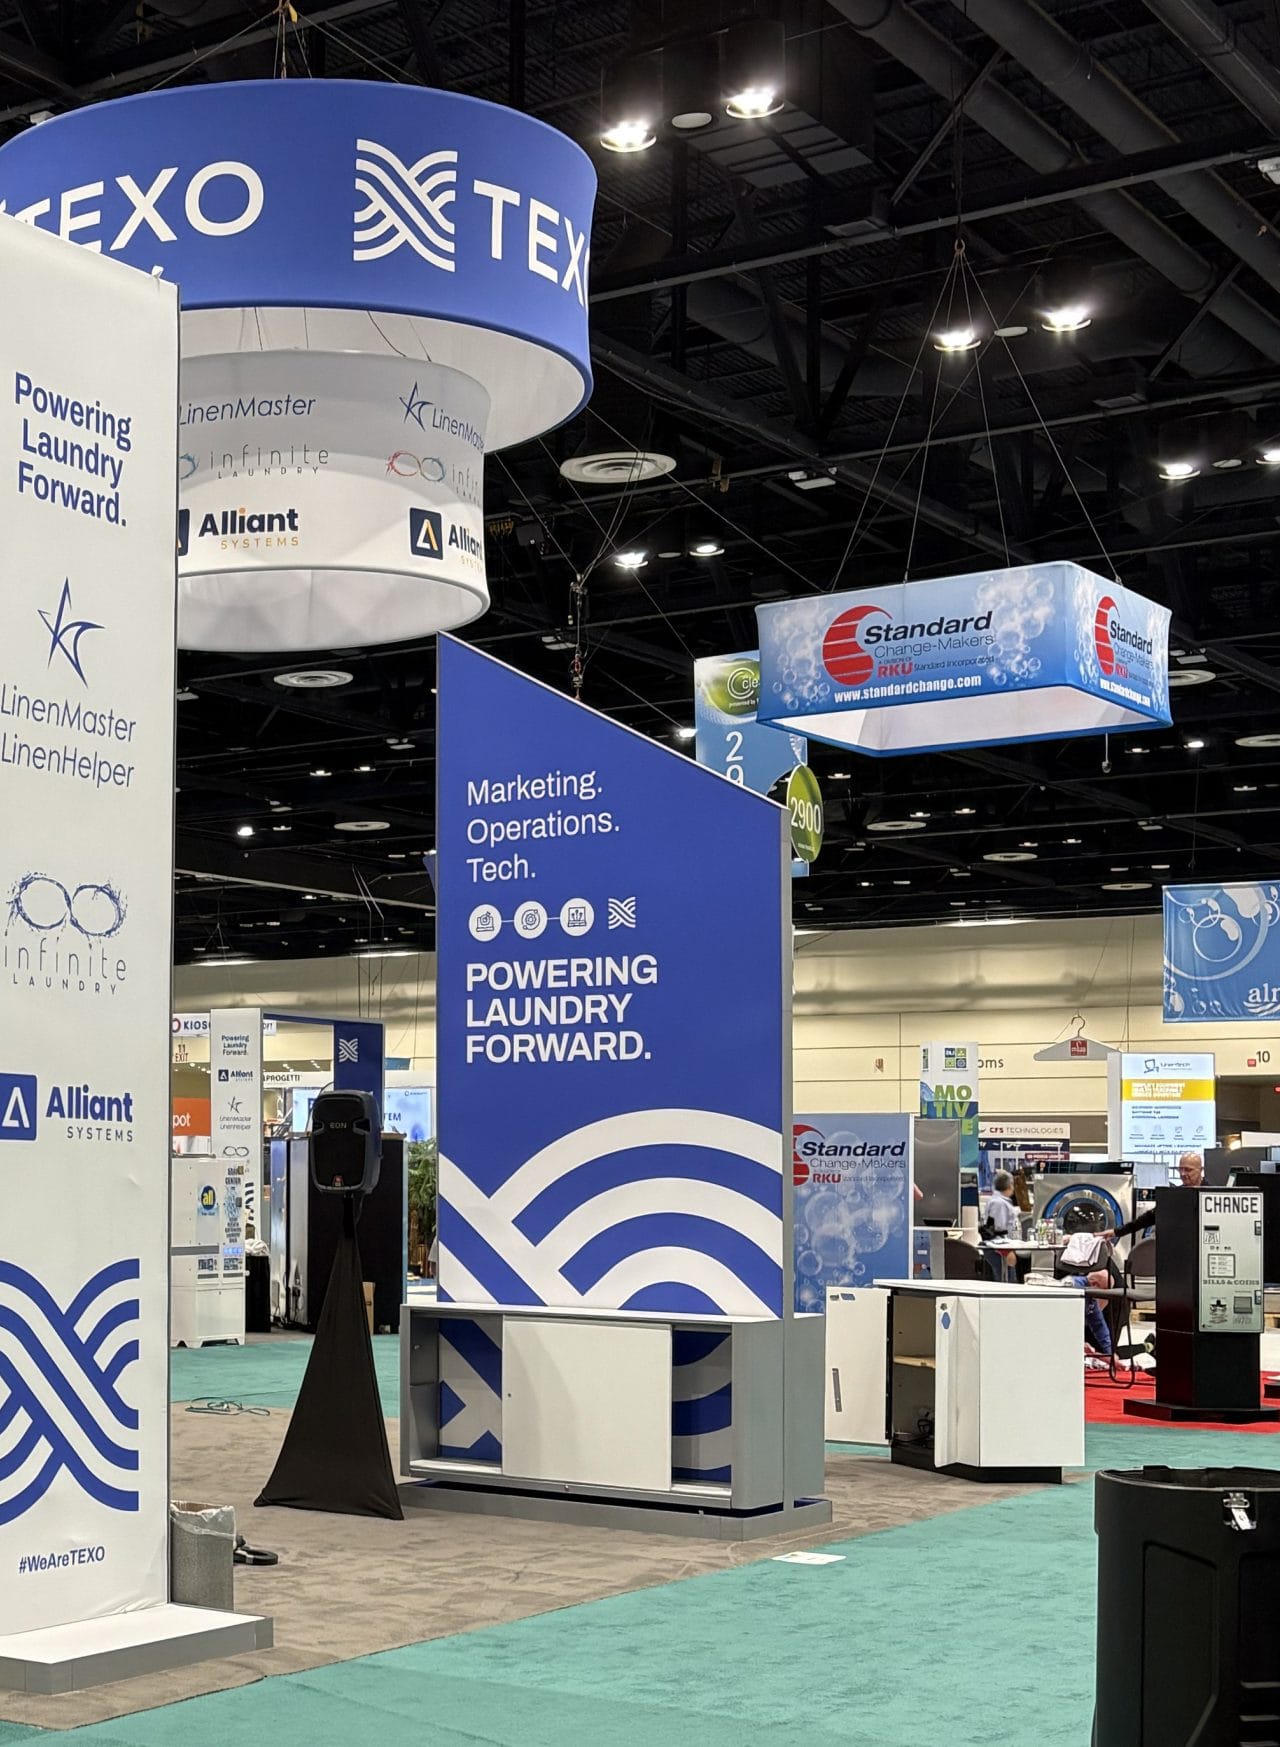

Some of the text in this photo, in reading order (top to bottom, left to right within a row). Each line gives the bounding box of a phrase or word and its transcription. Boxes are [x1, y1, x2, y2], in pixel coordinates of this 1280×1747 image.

[473, 179, 589, 314] TEX
[15, 371, 132, 452] Powering
[179, 394, 316, 425] LinenMaster
[22, 418, 124, 490] Laundry
[210, 444, 329, 470] infinite
[218, 466, 319, 479] LAUNDRY
[18, 460, 127, 527] Forward.
[198, 507, 300, 537] Alliant
[220, 536, 299, 550] SYSTEMS
[864, 611, 993, 645] Standard
[1110, 620, 1153, 655] Standard
[874, 634, 994, 658] Change-Makers
[877, 662, 913, 678] RKU
[914, 661, 945, 672] Standard
[834, 674, 982, 704] www.standardchange.com
[0, 683, 137, 742] LinenMaster
[1, 732, 135, 788] LinenHelper
[467, 770, 603, 806] Marketing.
[791, 797, 821, 834] 2900
[466, 810, 620, 848] Operations.
[466, 853, 536, 883] Tech.
[4, 937, 128, 982] infinite
[13, 973, 117, 995] LAUNDRY
[466, 954, 658, 992] POWERING
[466, 993, 633, 1027] LAUNDRY
[183, 1020, 210, 1030] KIOS
[221, 1034, 250, 1042] Powering
[175, 1053, 189, 1062] EXIT
[223, 1042, 247, 1050] Laundry
[466, 1031, 651, 1064] FORWARD.
[1256, 1050, 1270, 1063] 10
[230, 1070, 253, 1078] Alliant
[978, 1058, 1004, 1069] oms
[46, 1084, 133, 1123] Alliant
[935, 1085, 972, 1100] MO
[173, 1113, 191, 1128] pot
[933, 1102, 970, 1117] TIV
[67, 1126, 133, 1143] SYSTEMS
[801, 1141, 906, 1157] Standard
[810, 1158, 906, 1170] Change-Makers
[812, 1173, 841, 1183] RKU
[202, 1190, 213, 1205] all
[1205, 1196, 1259, 1214] CHANGE
[18, 1545, 105, 1574] #WeAreTEXO
